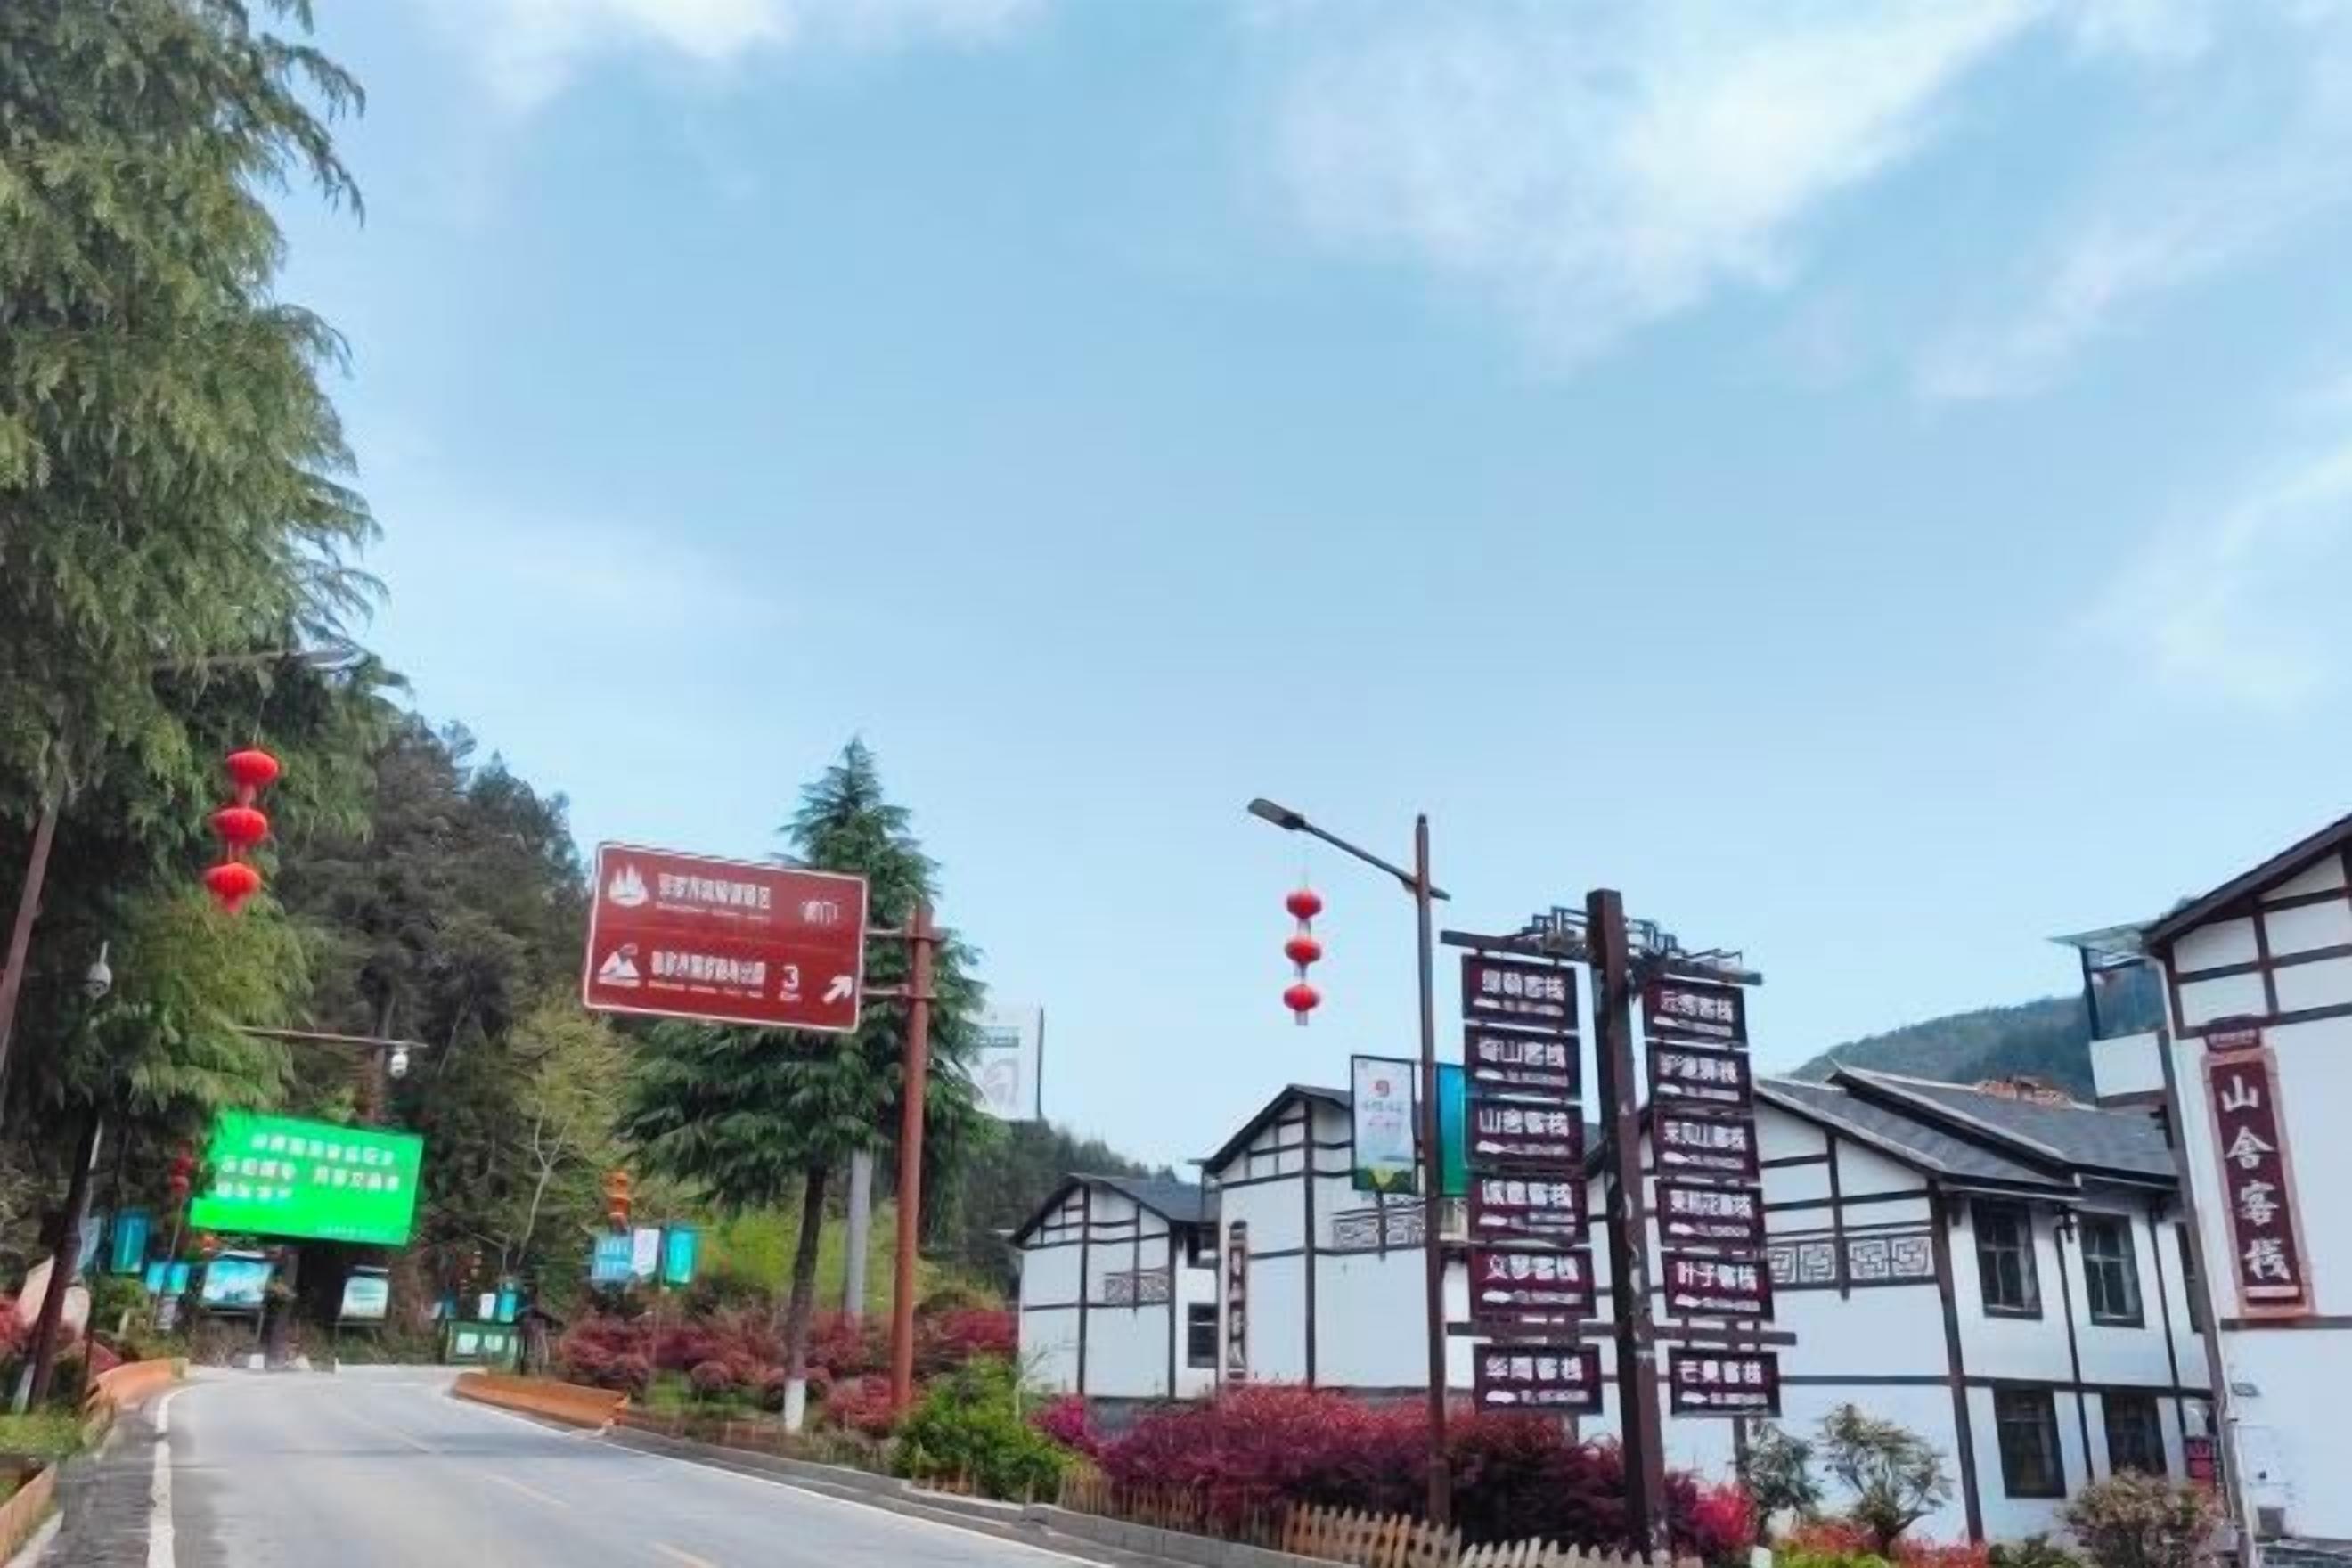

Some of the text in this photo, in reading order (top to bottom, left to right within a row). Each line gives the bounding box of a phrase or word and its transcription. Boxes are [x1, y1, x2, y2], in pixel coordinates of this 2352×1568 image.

[782, 964, 800, 990] 3
[2221, 1074, 2291, 1280] 山舍客栈
